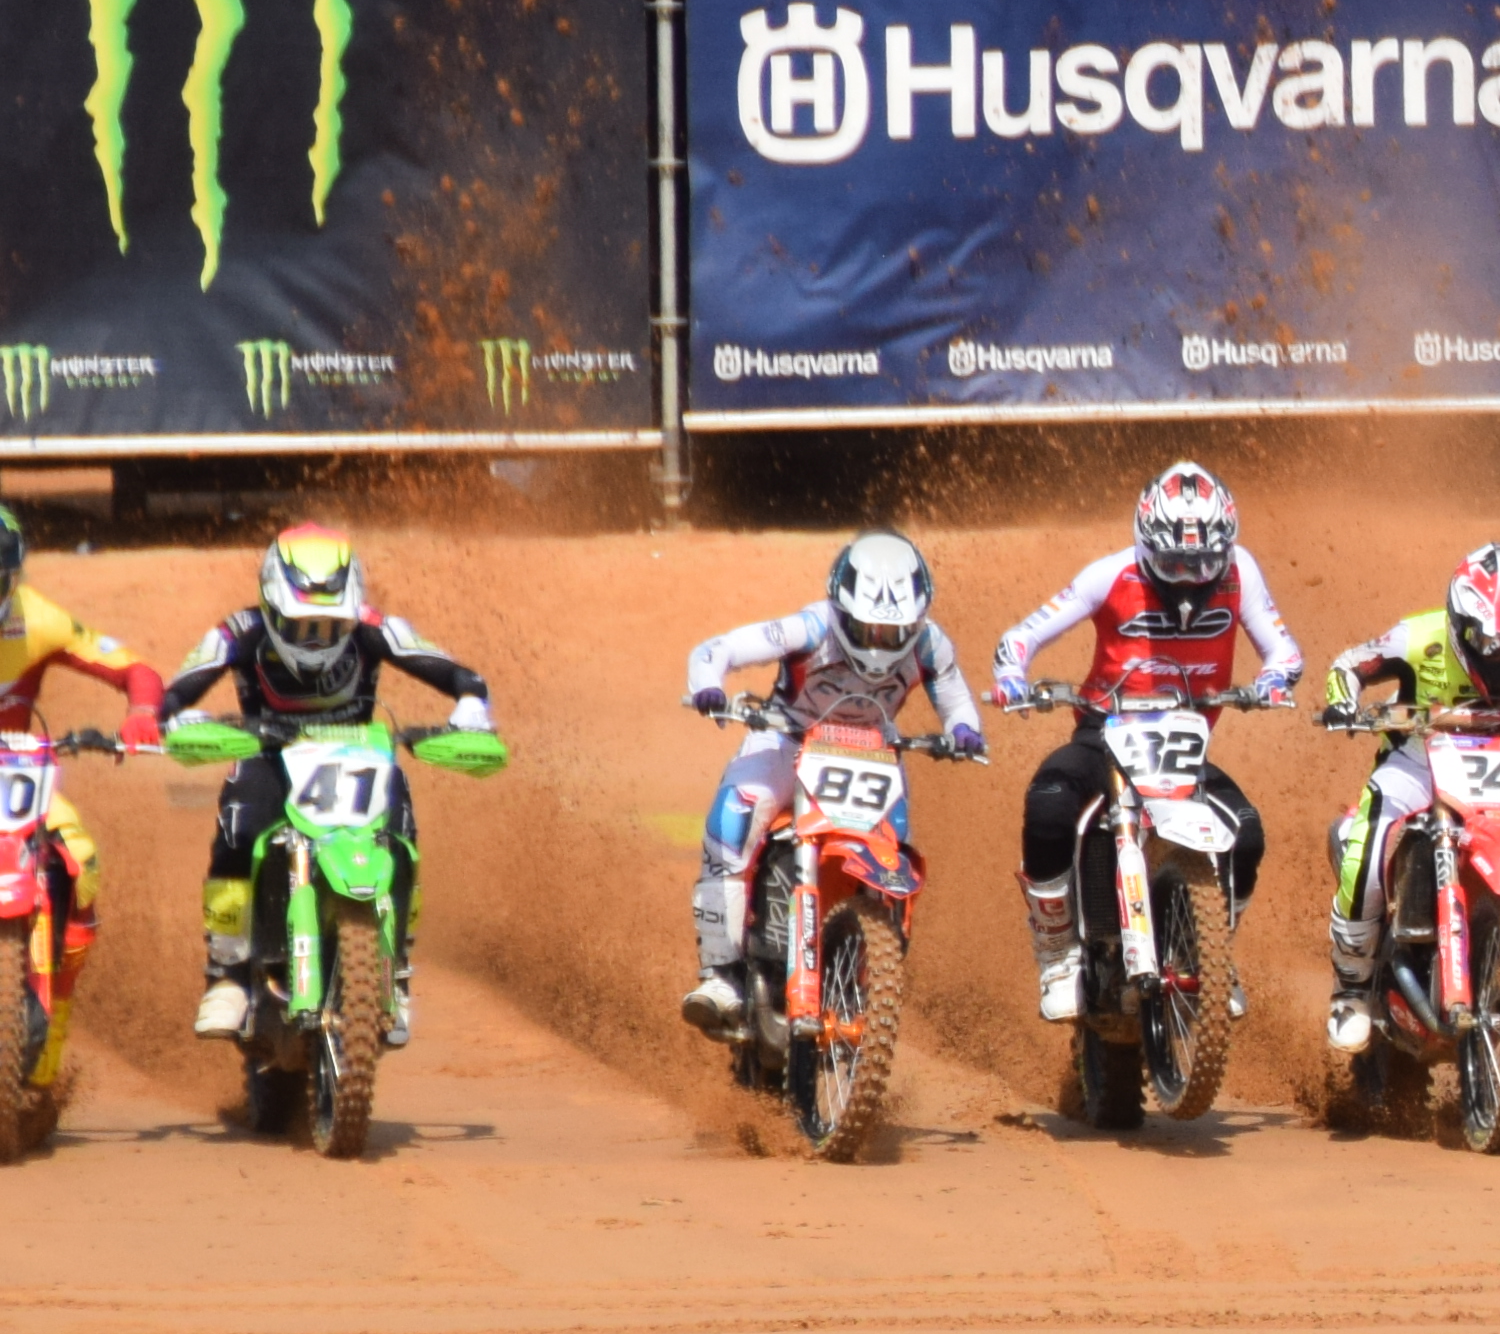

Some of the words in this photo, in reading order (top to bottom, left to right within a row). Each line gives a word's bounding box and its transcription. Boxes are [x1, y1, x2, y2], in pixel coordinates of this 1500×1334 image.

[742, 346, 879, 379] Husqvarna
[977, 342, 1114, 374] Husqvarna
[1212, 337, 1348, 369] Husqvarna
[296, 762, 378, 817] 41
[814, 765, 893, 812] 83
